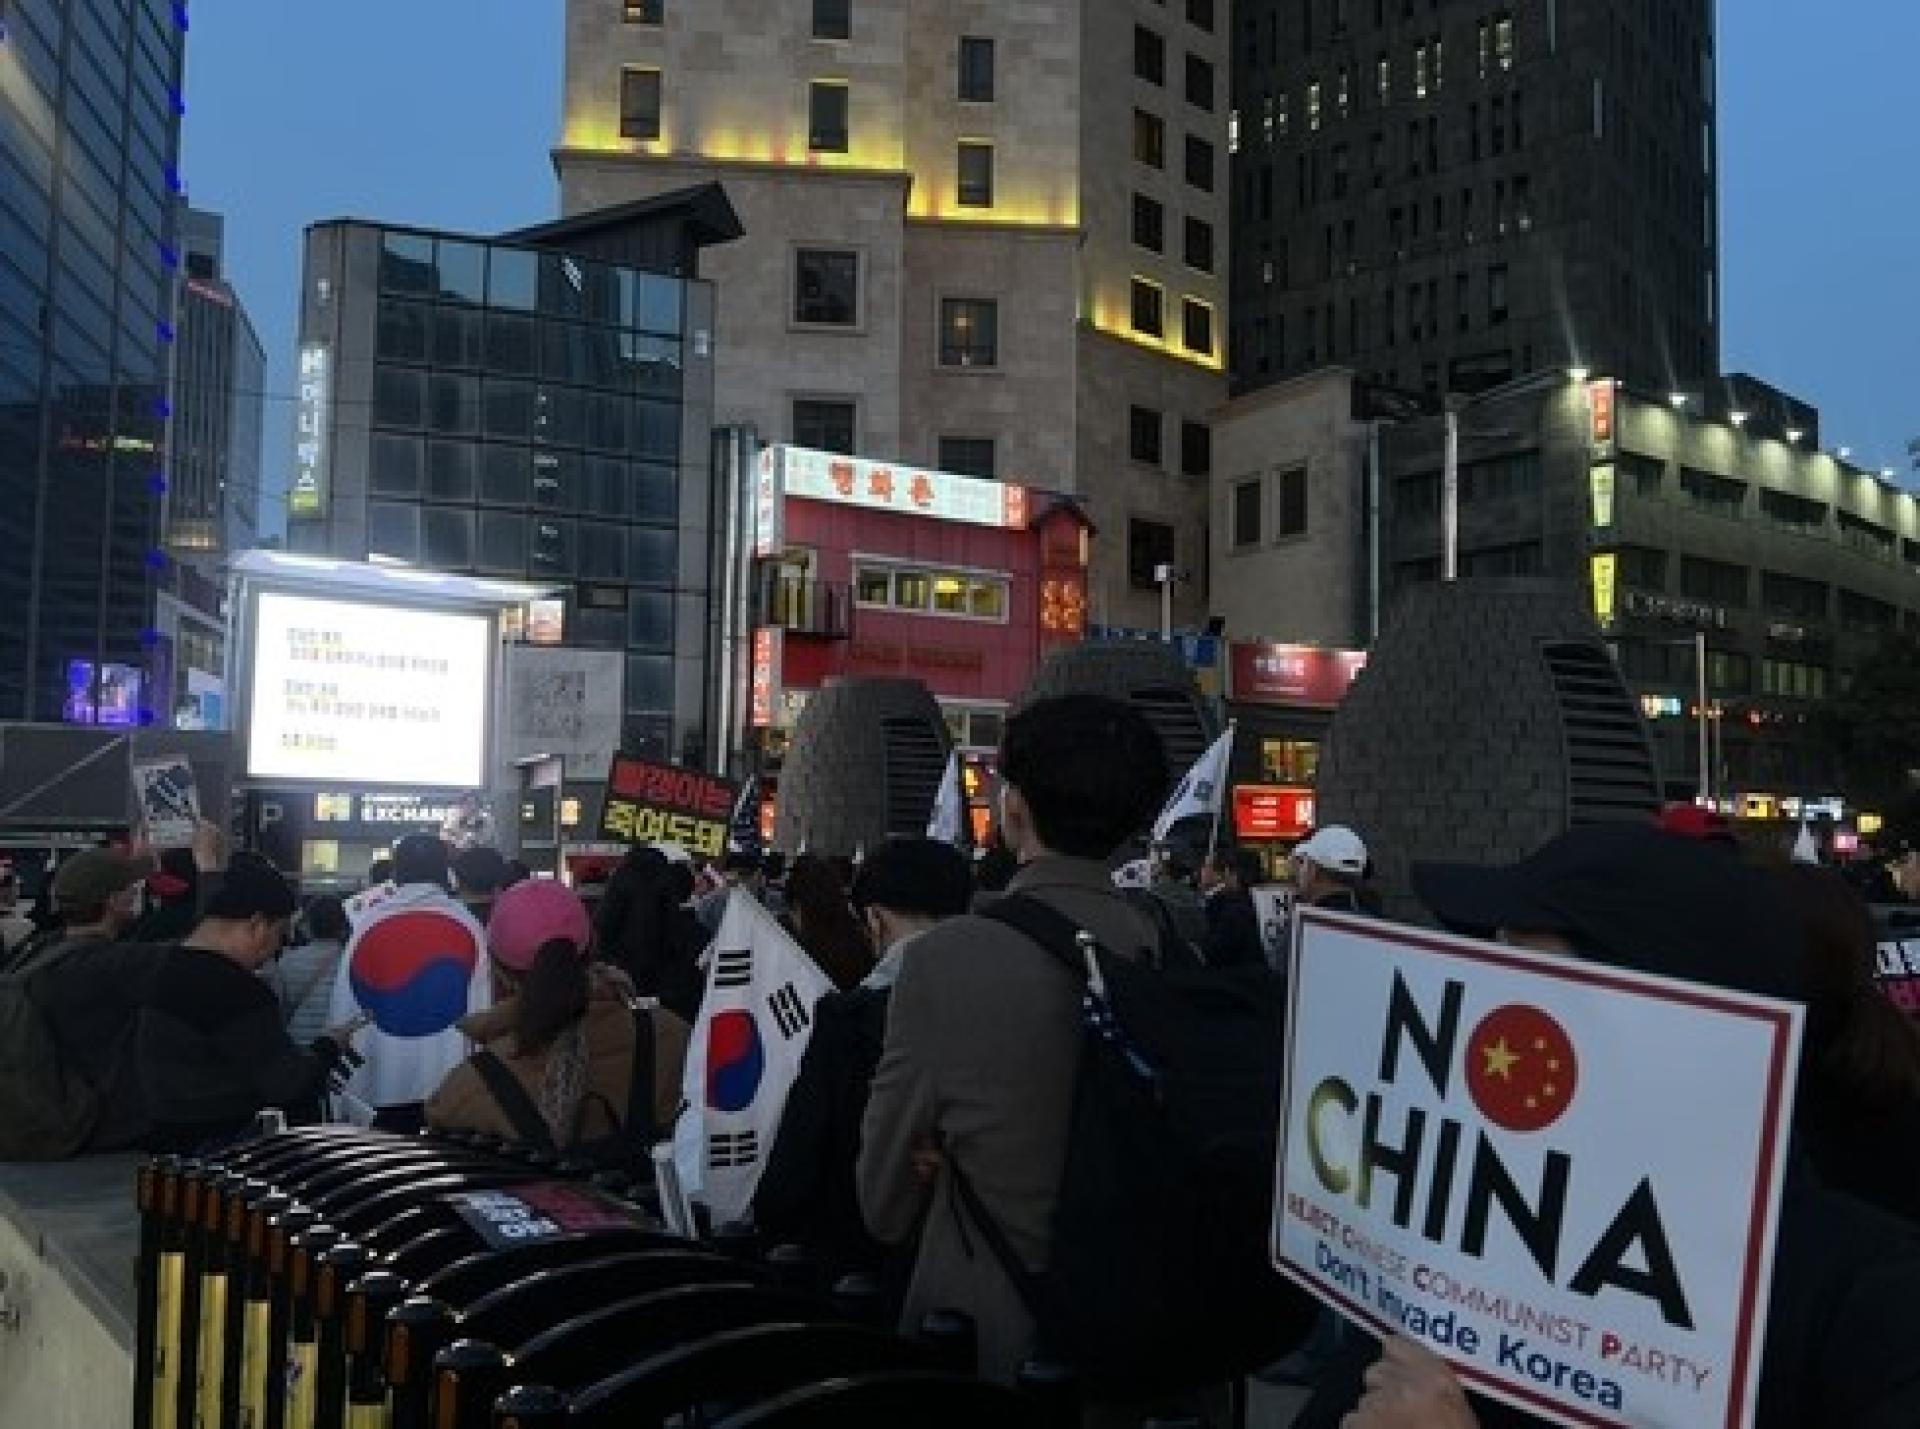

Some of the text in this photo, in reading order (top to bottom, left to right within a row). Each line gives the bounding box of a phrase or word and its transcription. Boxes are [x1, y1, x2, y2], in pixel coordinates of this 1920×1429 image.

[1306, 1075, 1696, 1331] CHINA
[1377, 1275, 1481, 1356] invade
[1496, 1332, 1625, 1411] Korea
[1413, 1263, 1592, 1350] COMMUNIST
[1602, 1330, 1713, 1392] PARTY
